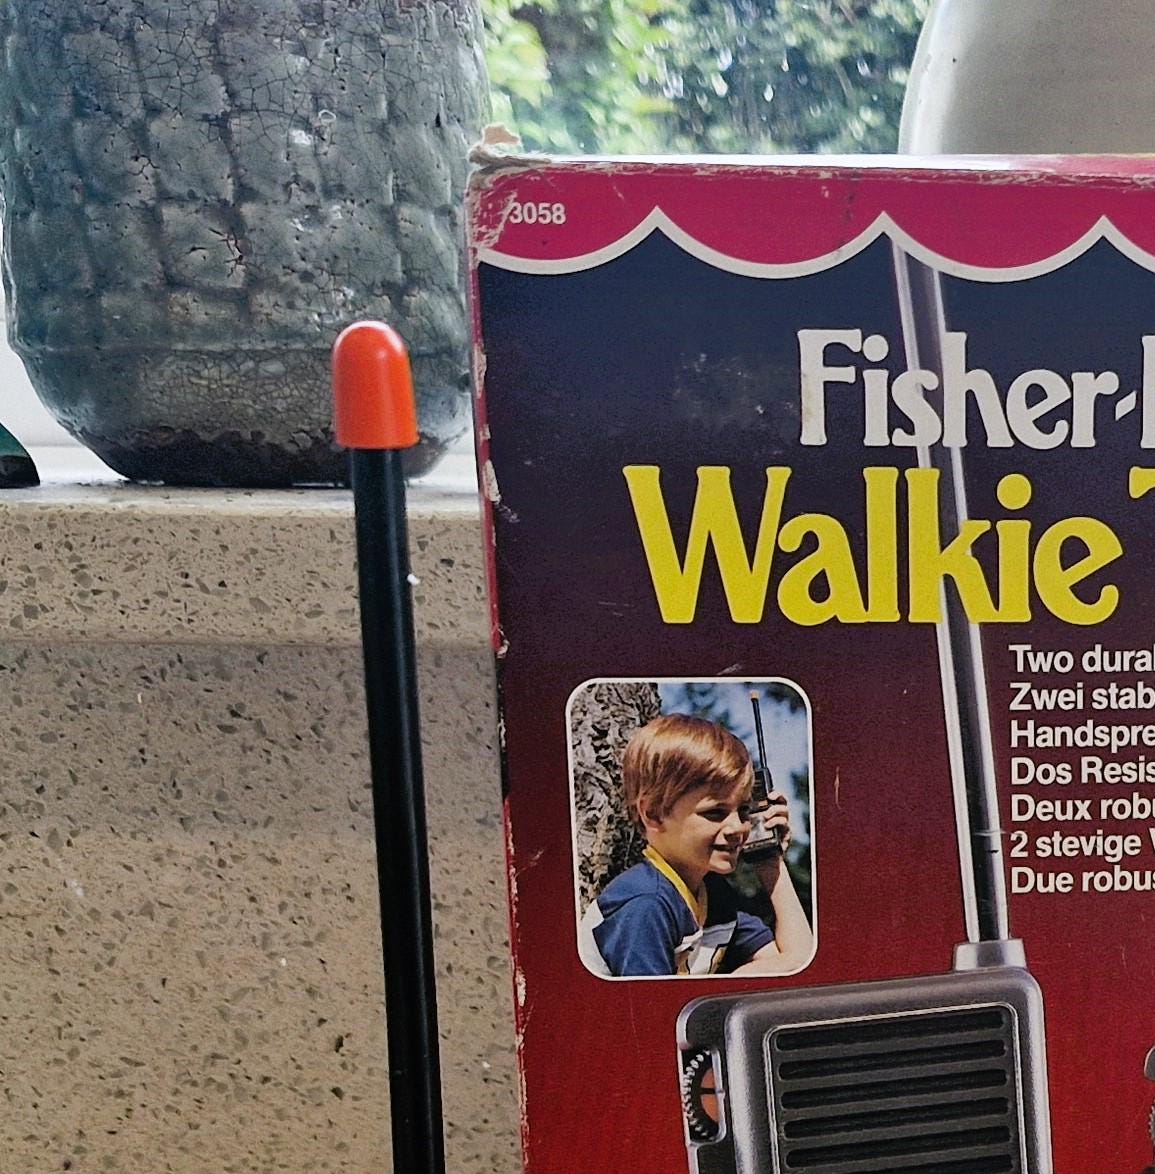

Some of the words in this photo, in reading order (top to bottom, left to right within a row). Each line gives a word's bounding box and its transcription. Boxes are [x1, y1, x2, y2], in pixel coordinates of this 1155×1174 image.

[509, 202, 566, 224] 3058
[622, 464, 1123, 626] Walkie
[1009, 644, 1074, 673] Two
[1009, 682, 1084, 711] Zwei
[1010, 756, 1072, 785] Dos
[1011, 793, 1091, 821] Deux
[1010, 833, 1029, 858] 2
[1036, 829, 1142, 862] stevige
[1011, 866, 1073, 894] Due
